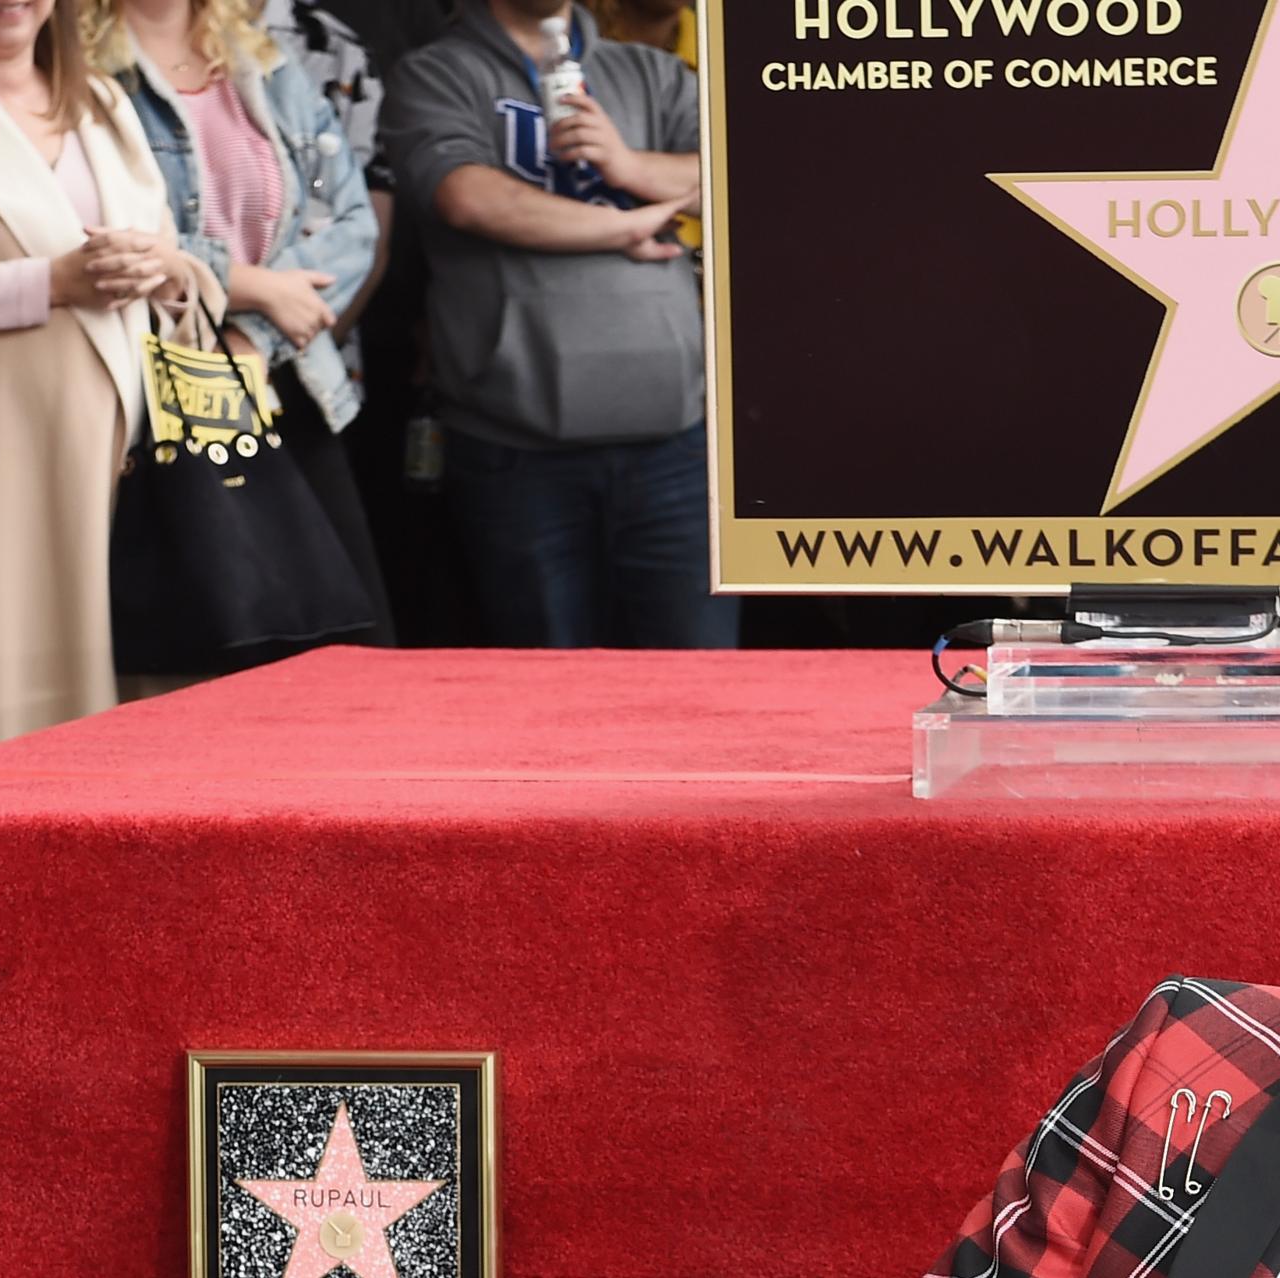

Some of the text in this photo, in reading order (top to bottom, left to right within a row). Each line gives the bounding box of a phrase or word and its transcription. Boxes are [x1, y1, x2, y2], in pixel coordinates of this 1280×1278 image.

[794, 0, 1183, 39] HOLLYWOOD
[761, 55, 1218, 91] CHAMBER OF COMMERCE
[293, 1188, 392, 1208] RUPAUL
